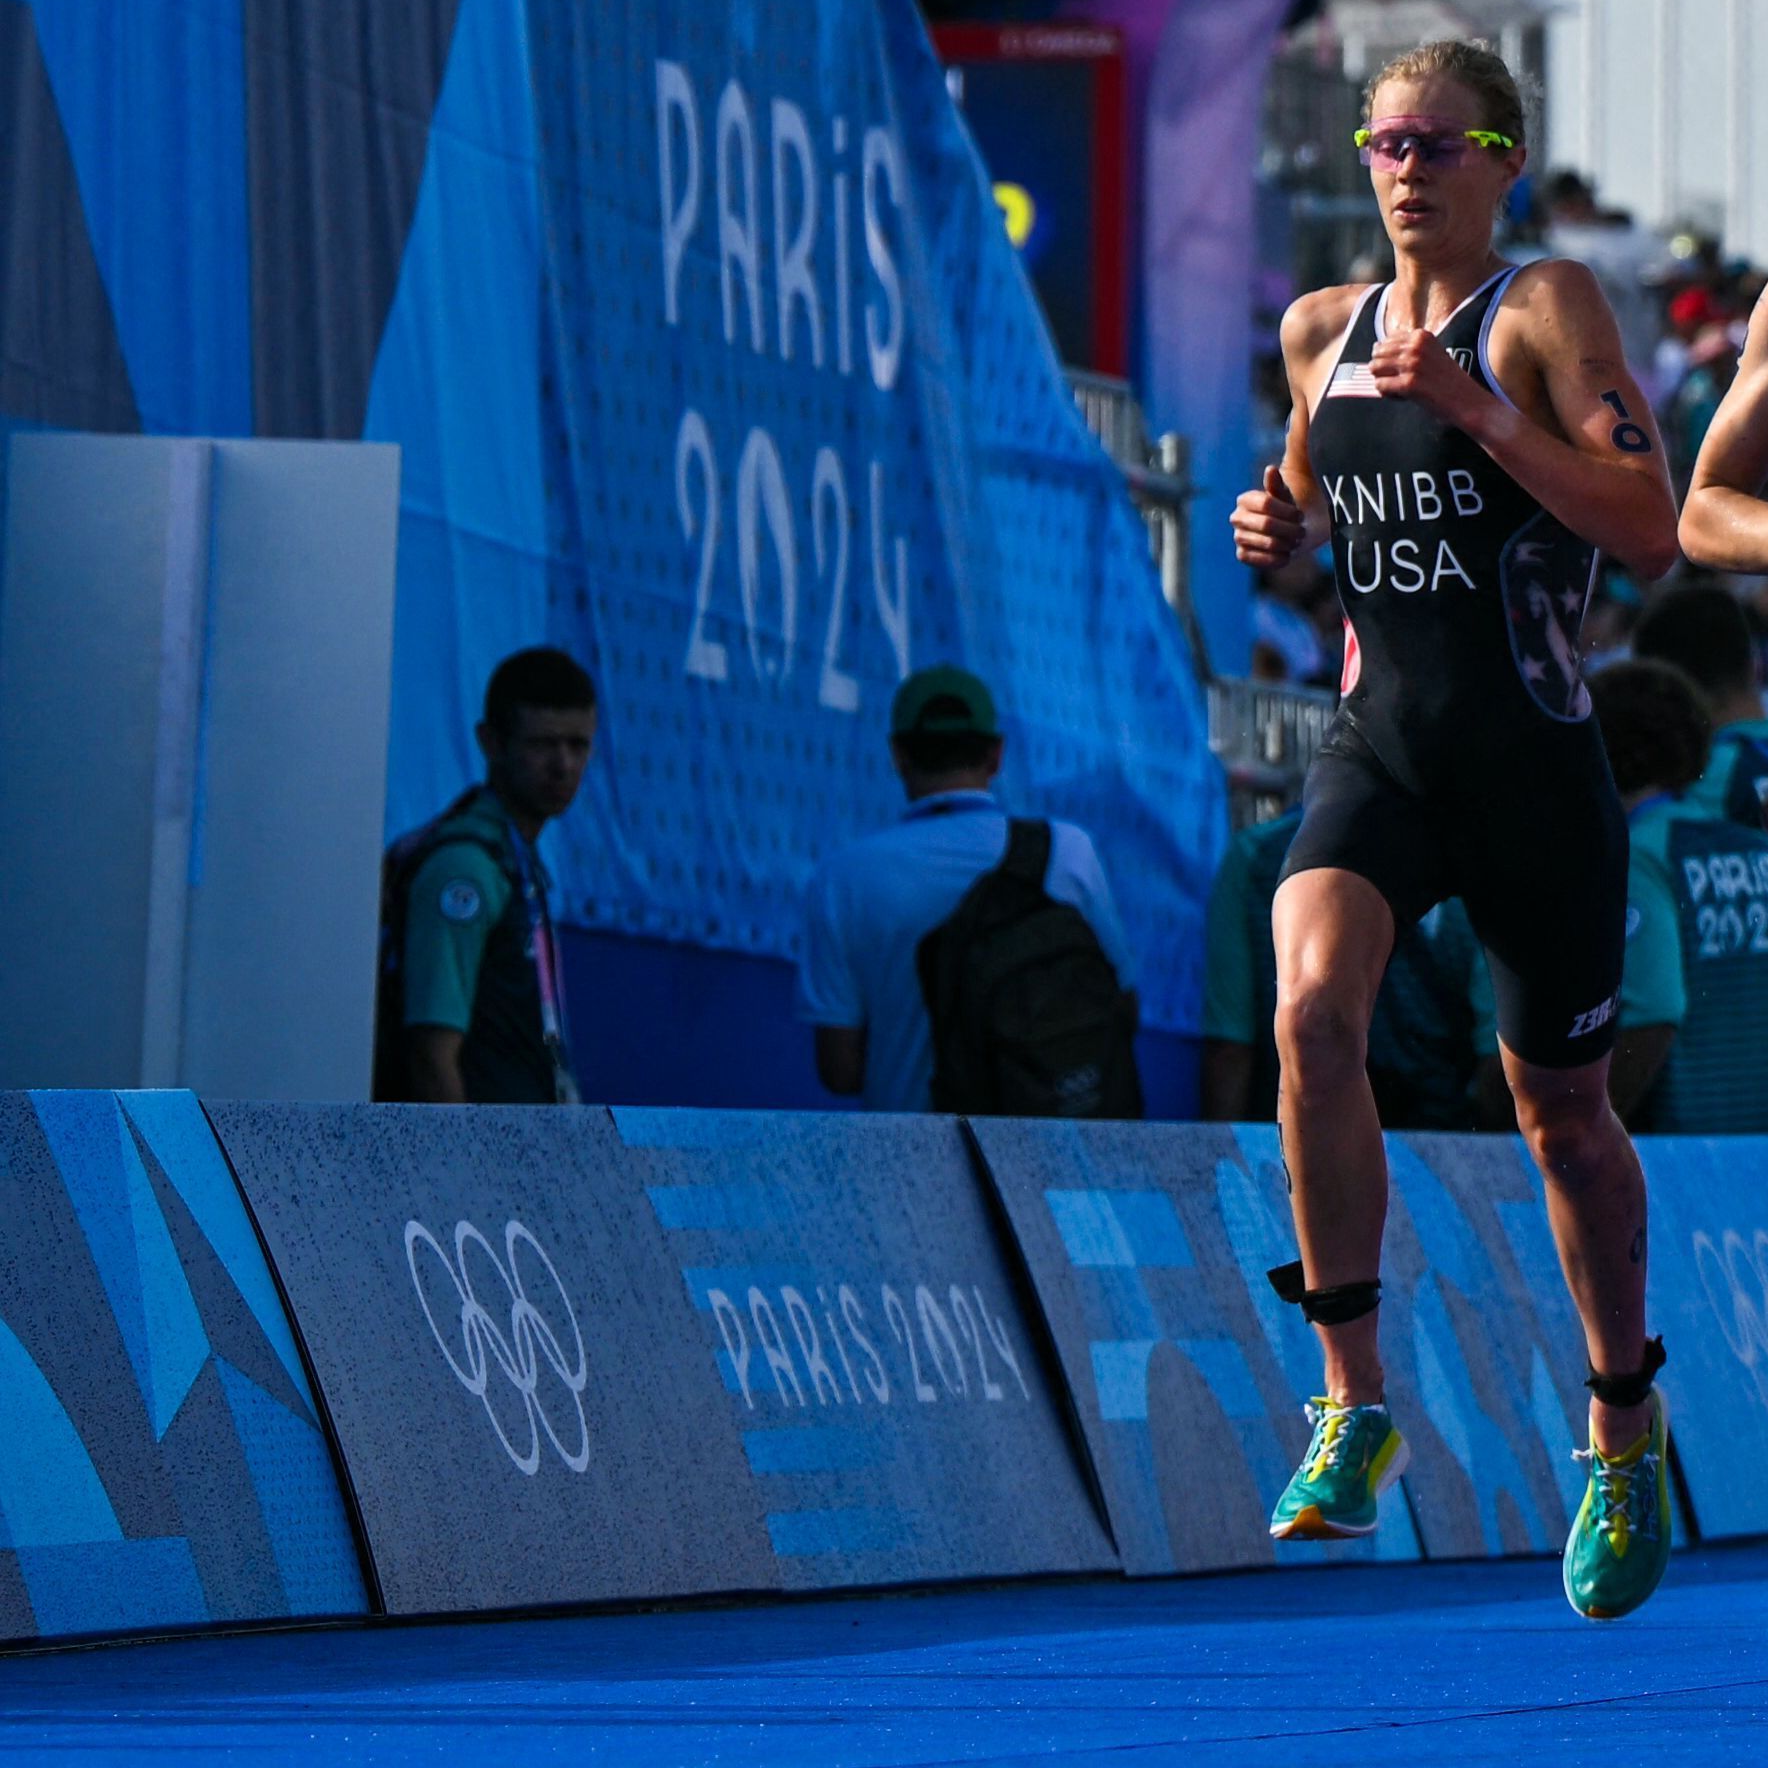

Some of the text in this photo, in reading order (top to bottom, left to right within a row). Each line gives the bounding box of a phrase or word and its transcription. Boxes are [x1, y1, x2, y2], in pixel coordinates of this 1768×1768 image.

[1600, 388, 1652, 453] 10
[1322, 468, 1484, 525] KNIBB
[673, 408, 915, 714] 2024
[1346, 538, 1476, 593] USA
[880, 1284, 1030, 1403] 2024
